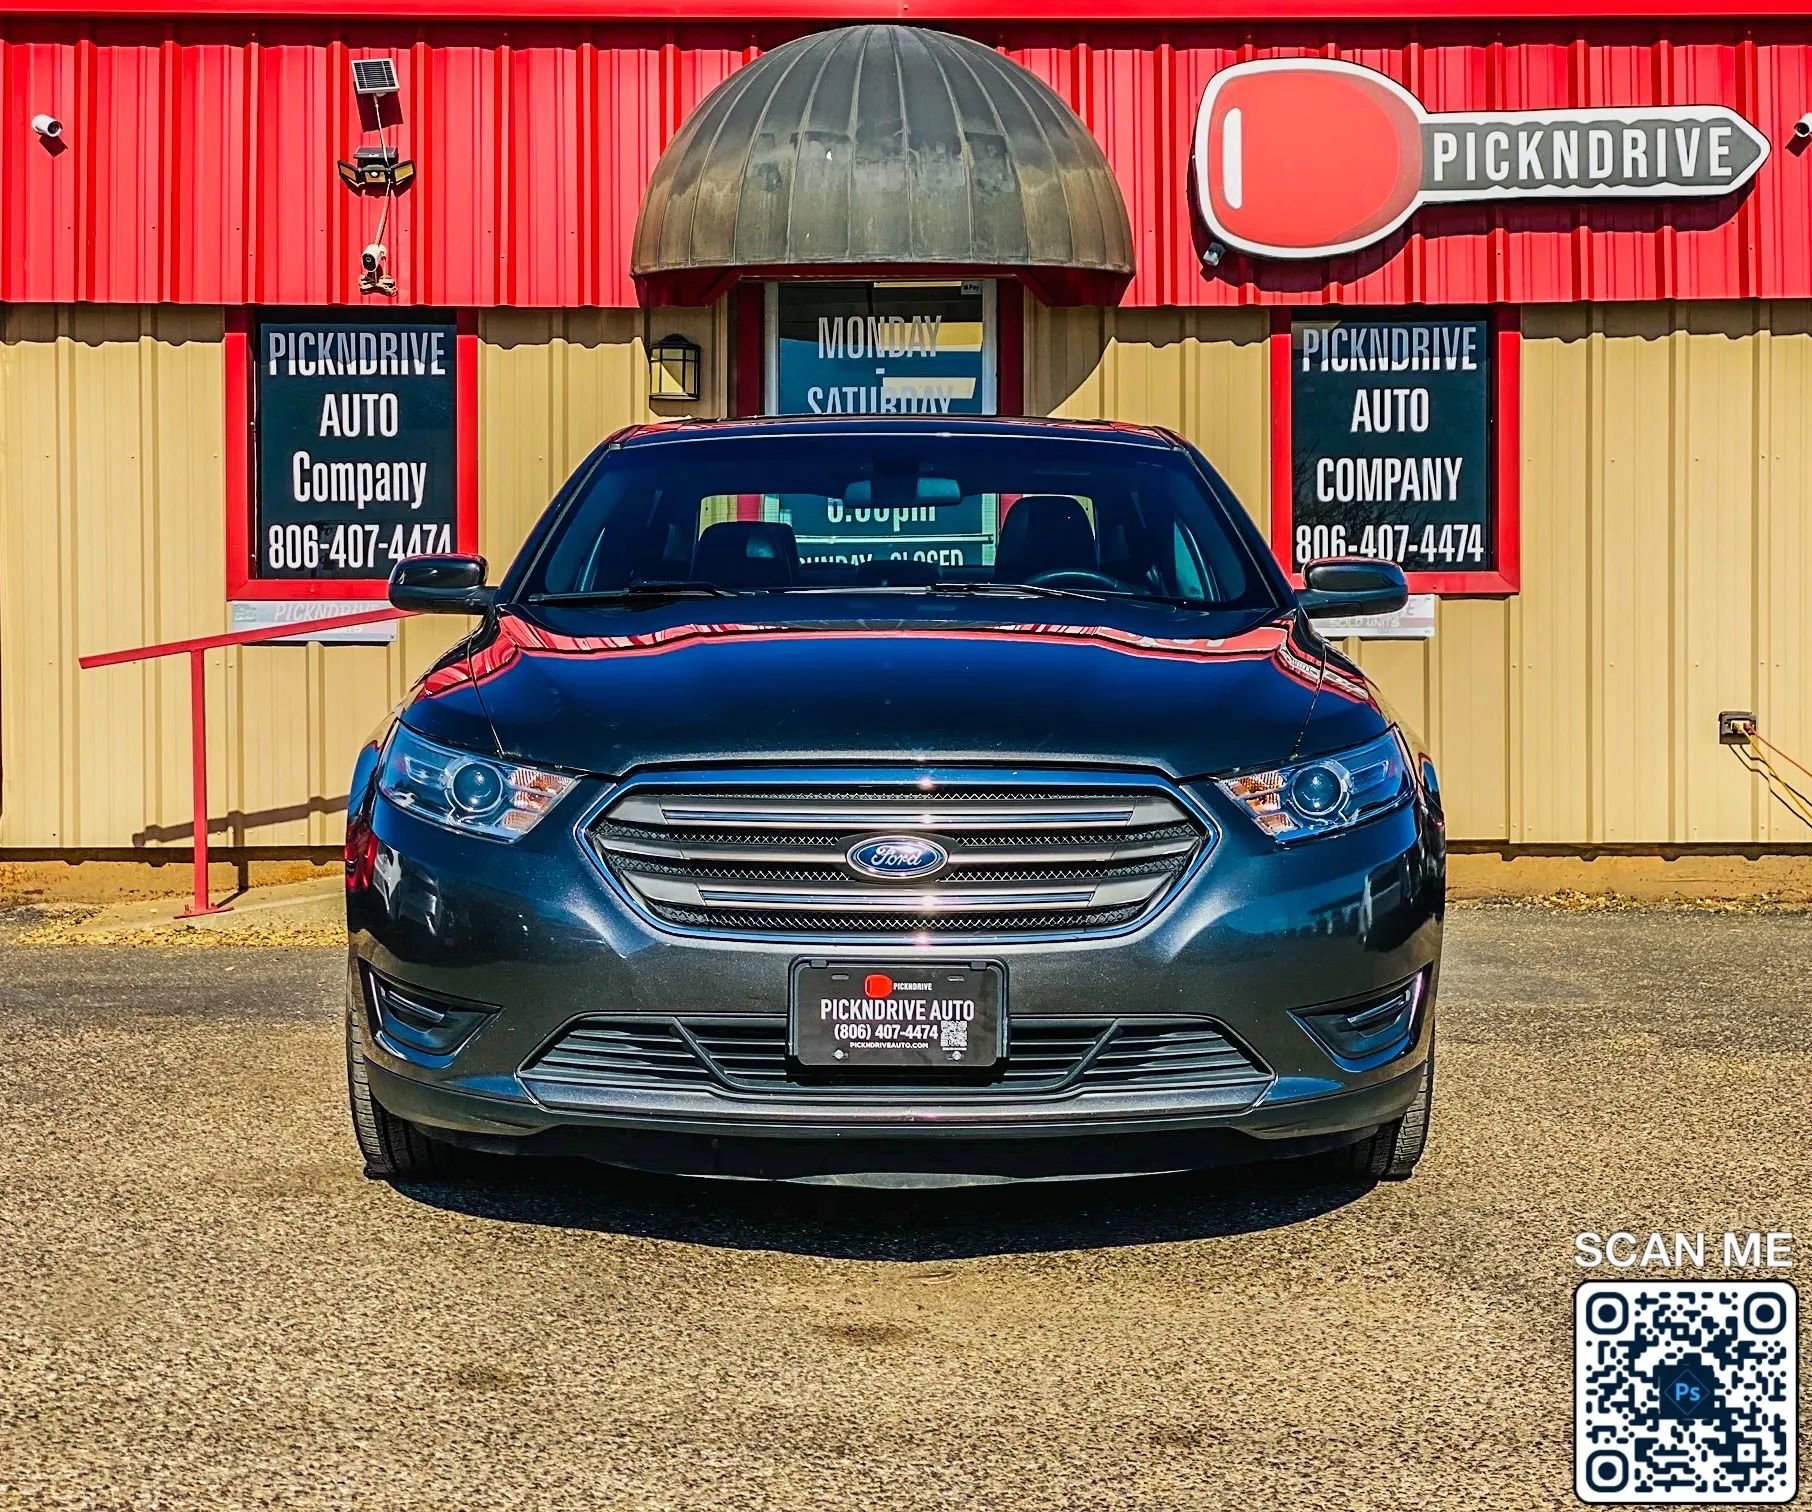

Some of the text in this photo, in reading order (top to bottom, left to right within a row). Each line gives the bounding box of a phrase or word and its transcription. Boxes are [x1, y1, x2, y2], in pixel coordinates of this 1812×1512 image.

[1433, 127, 1733, 182] PICKNDRIVE
[269, 332, 446, 376] PICKNDRIVE
[818, 315, 942, 359] MONDAY
[1302, 327, 1477, 372] PICKNDRIVE
[319, 393, 399, 438] AUTO
[1351, 388, 1430, 433] AUTO
[293, 451, 427, 510] Company
[1317, 457, 1463, 501] COMPANY
[269, 524, 451, 568] 806-407-4474
[1296, 524, 1484, 563] 806-407-4474
[870, 845, 922, 866] Ford
[893, 982, 932, 991] PICKNDRIVE
[820, 999, 974, 1021] PICKNDRIVE AUTO
[834, 1023, 939, 1040] (806) 407-4474
[850, 1041, 928, 1049] PICKNDRIVEAUTO.COM
